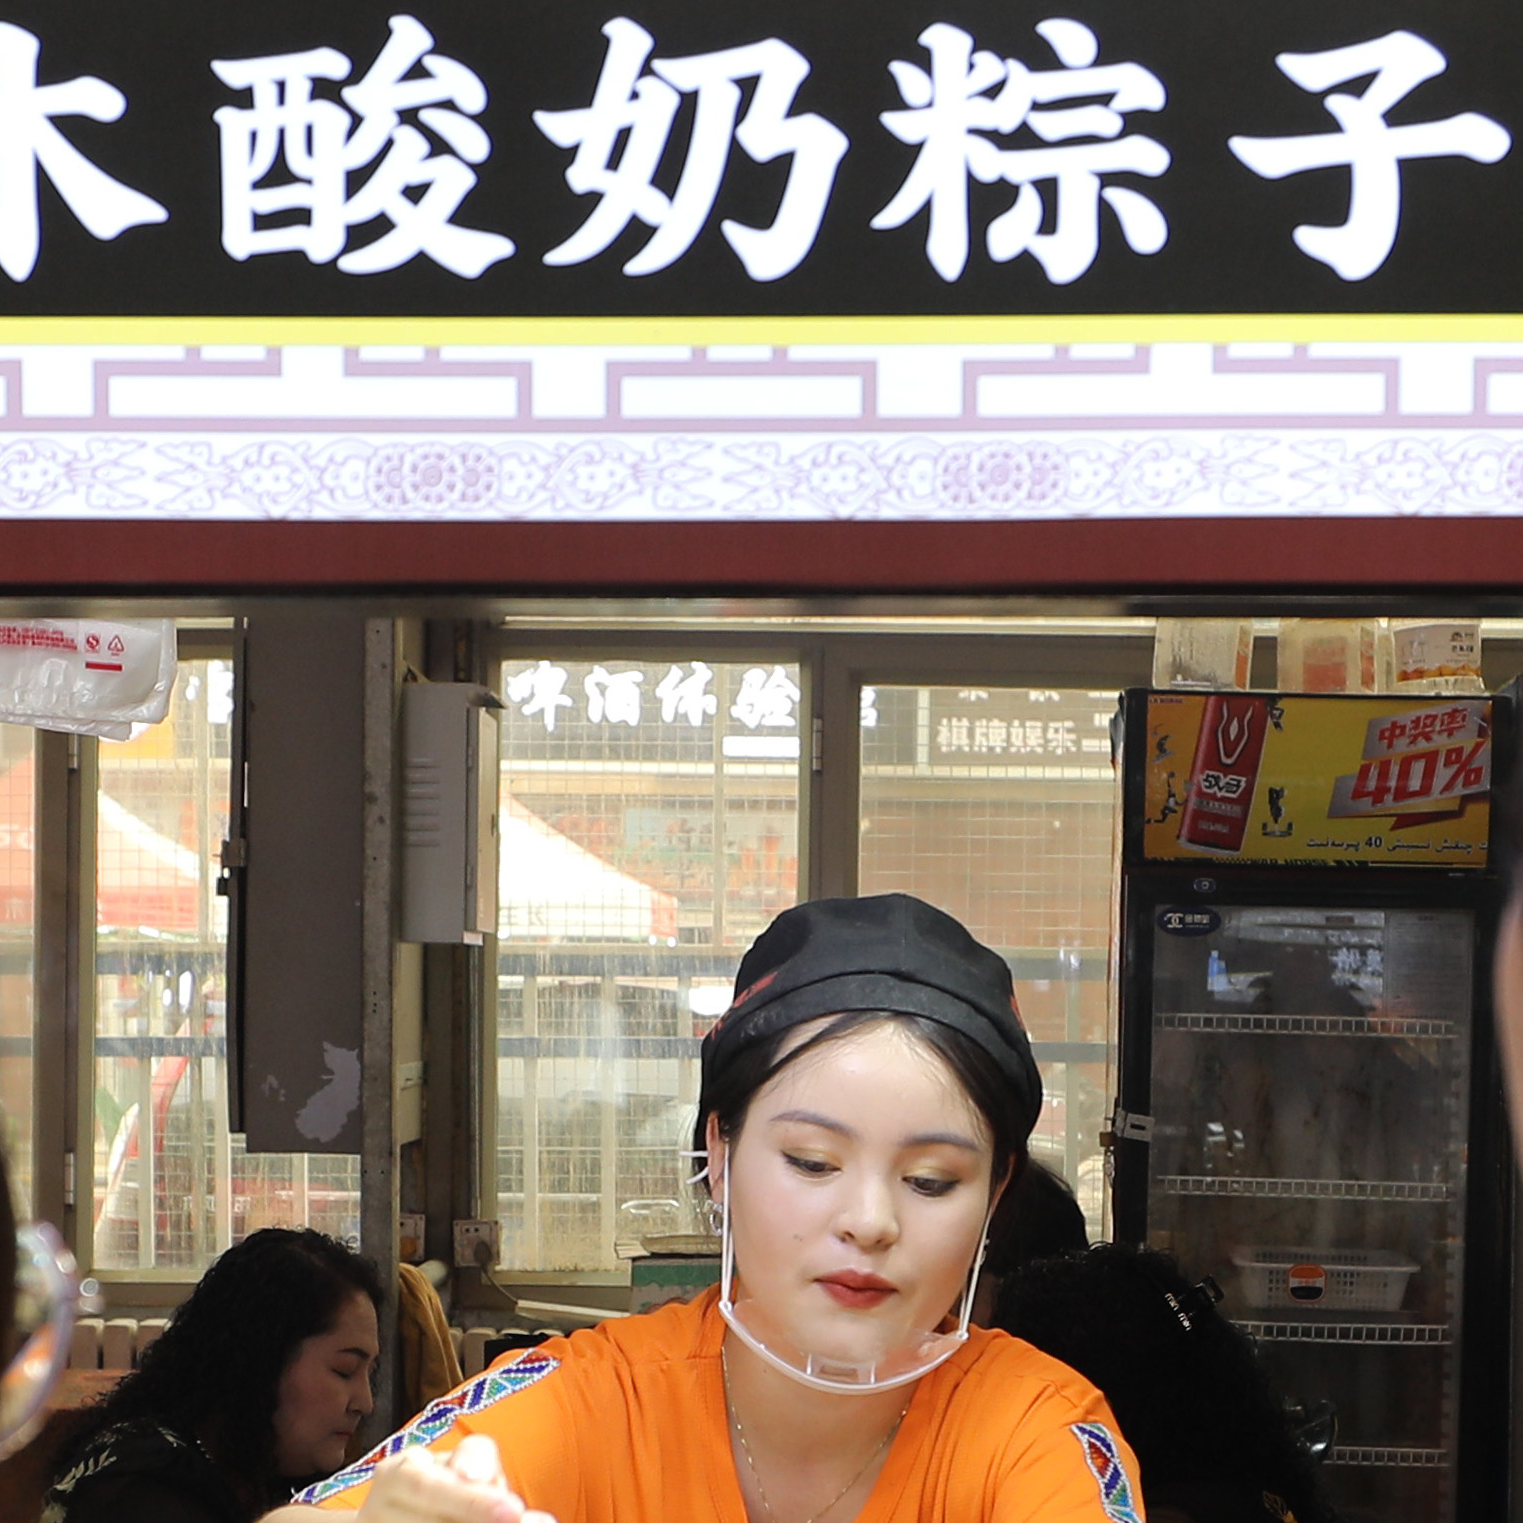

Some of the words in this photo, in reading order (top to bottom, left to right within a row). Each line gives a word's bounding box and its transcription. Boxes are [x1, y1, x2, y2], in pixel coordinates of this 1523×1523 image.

[936, 716, 1078, 756] 棋牌娱乐
[1378, 707, 1470, 750] 中奖率
[1350, 739, 1488, 806] 40%
[1364, 836, 1383, 849] 40
